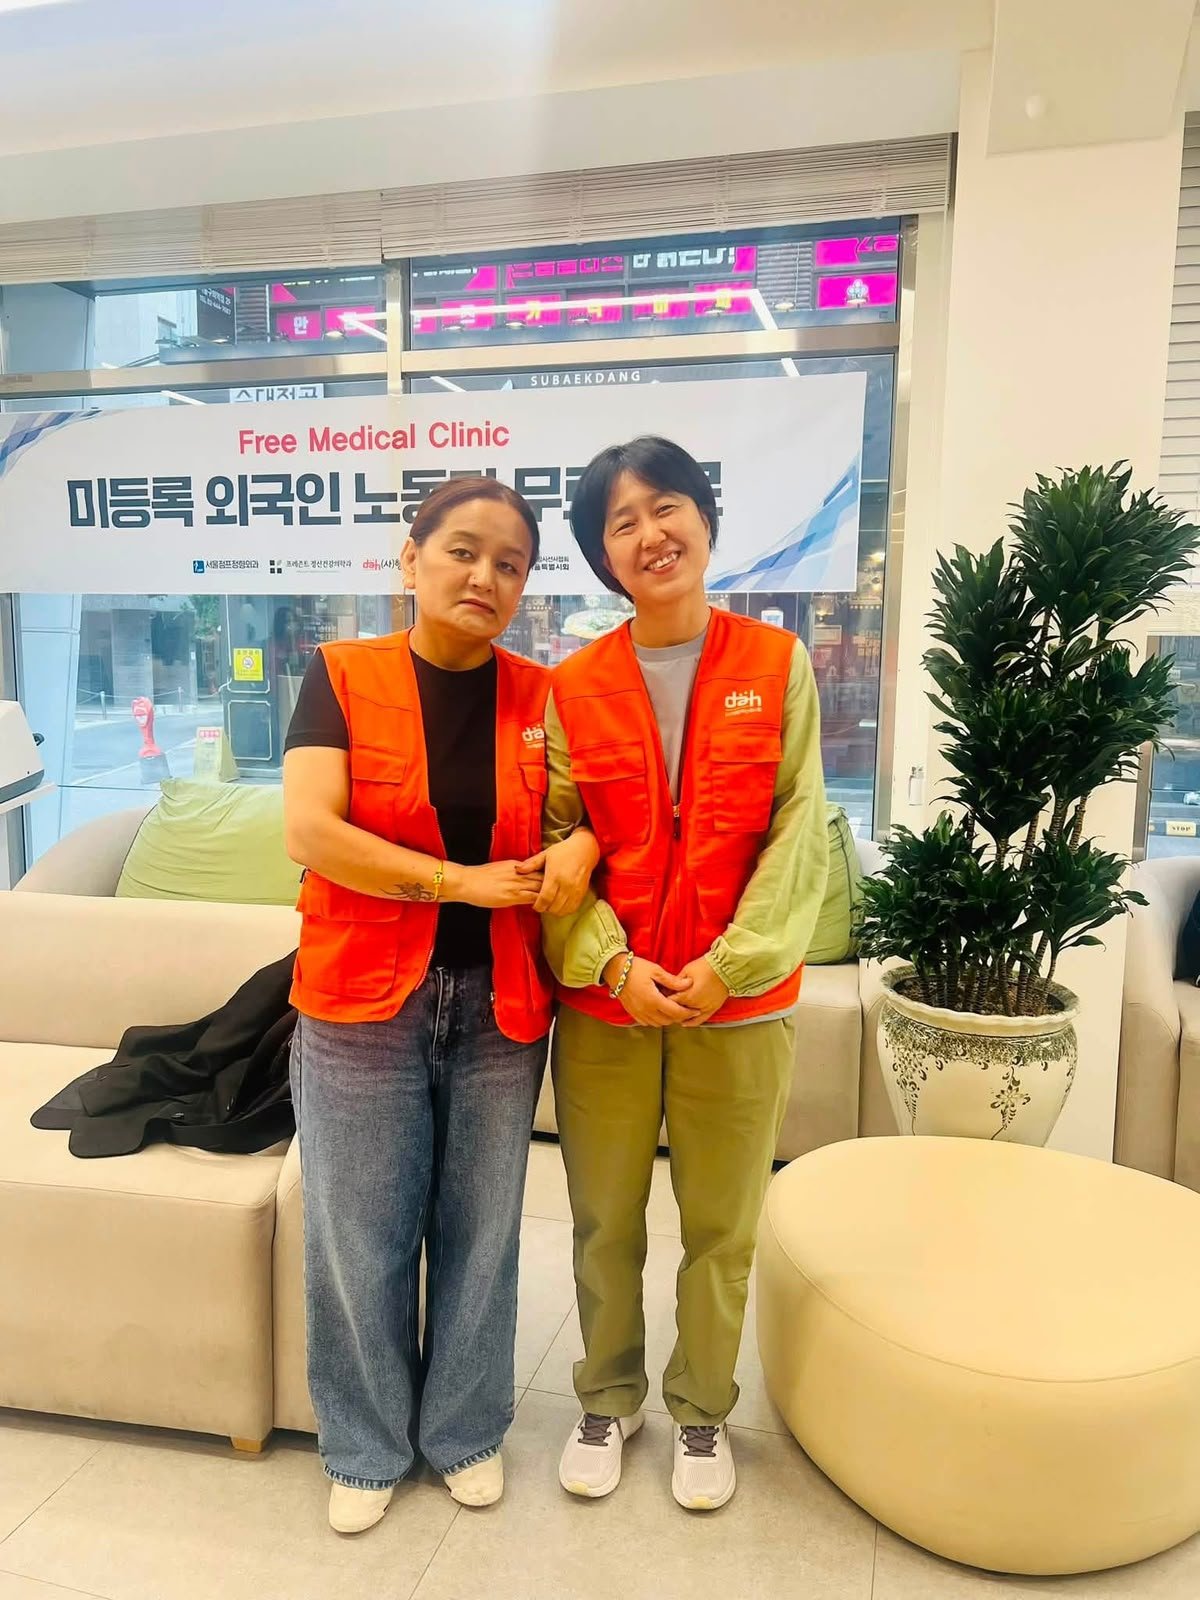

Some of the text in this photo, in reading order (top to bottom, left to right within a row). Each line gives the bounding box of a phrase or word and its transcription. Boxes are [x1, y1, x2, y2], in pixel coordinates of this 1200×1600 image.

[530, 371, 641, 386] SUBAEKDANG
[239, 420, 510, 454] Free Medical Clinic
[67, 476, 194, 528] 미등록
[206, 472, 342, 526] 외국인
[353, 468, 497, 524] 노동
